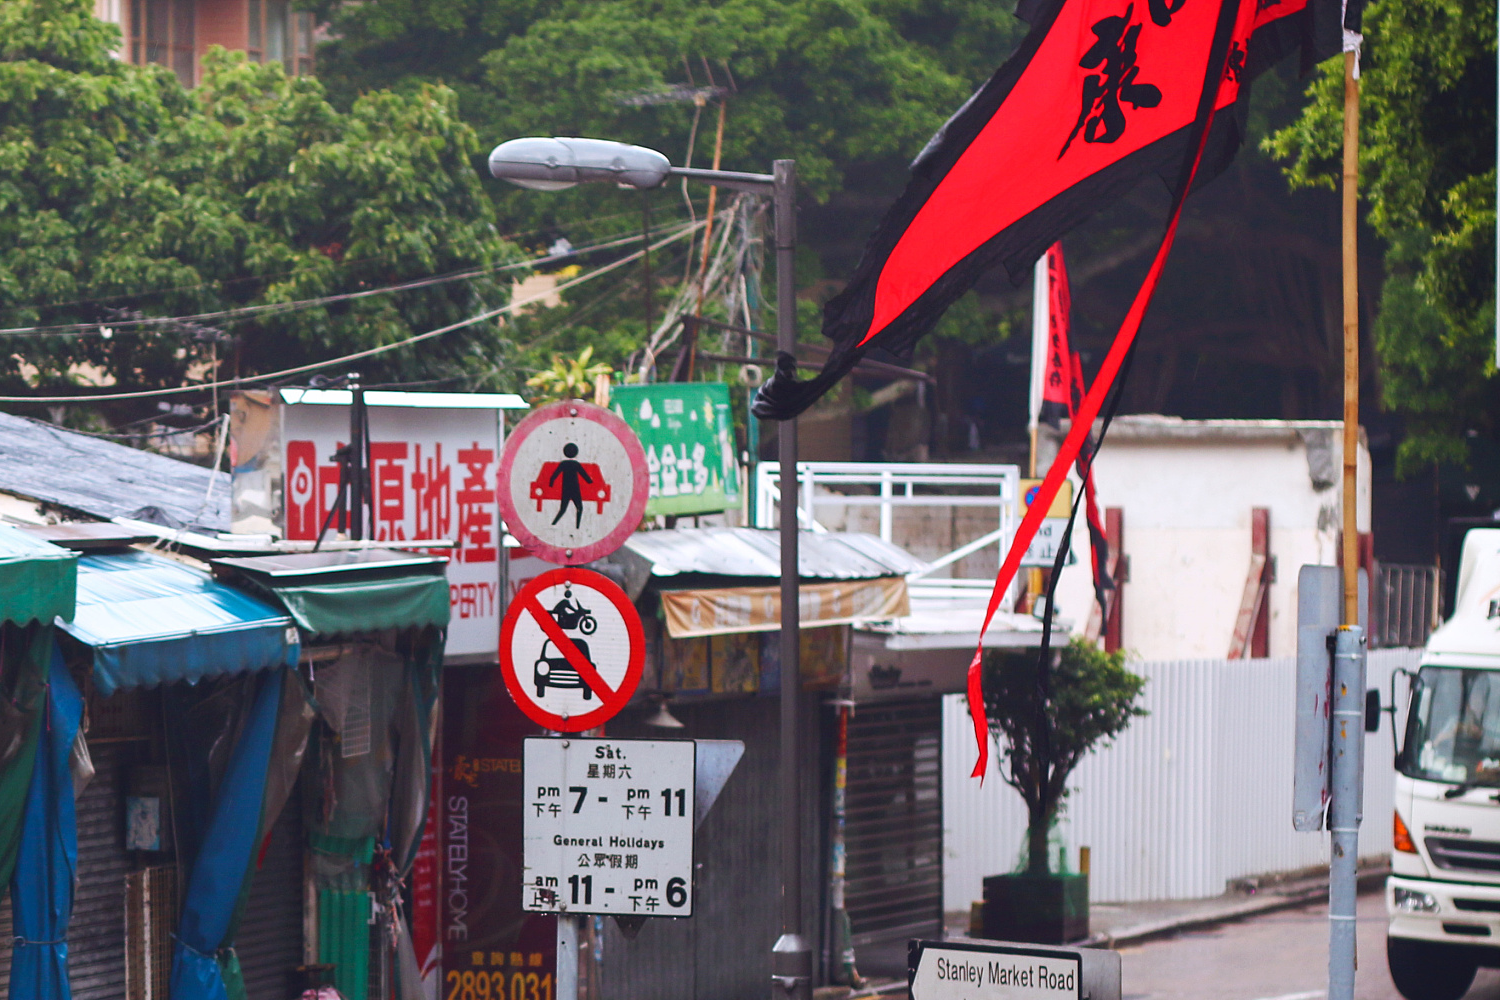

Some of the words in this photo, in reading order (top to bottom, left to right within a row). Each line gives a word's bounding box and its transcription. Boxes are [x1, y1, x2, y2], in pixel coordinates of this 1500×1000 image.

[595, 746, 627, 760] Sat.
[587, 763, 632, 779] 星期六
[537, 786, 560, 799] pm
[568, 786, 588, 814] 7
[627, 788, 650, 801] pm
[661, 788, 686, 817] 11
[532, 803, 562, 818] 下午
[621, 805, 652, 821] 下午
[553, 835, 603, 847] General
[609, 836, 665, 851] Holidays
[577, 853, 639, 869] 公眾假期
[535, 876, 559, 887] am
[568, 875, 593, 905] 11
[634, 878, 659, 892] pm
[666, 876, 688, 908] 6
[529, 891, 561, 909] 上午
[628, 896, 660, 912] 下午
[937, 957, 984, 989] Stanley
[988, 961, 1034, 988] Market
[1038, 965, 1075, 991] Road
